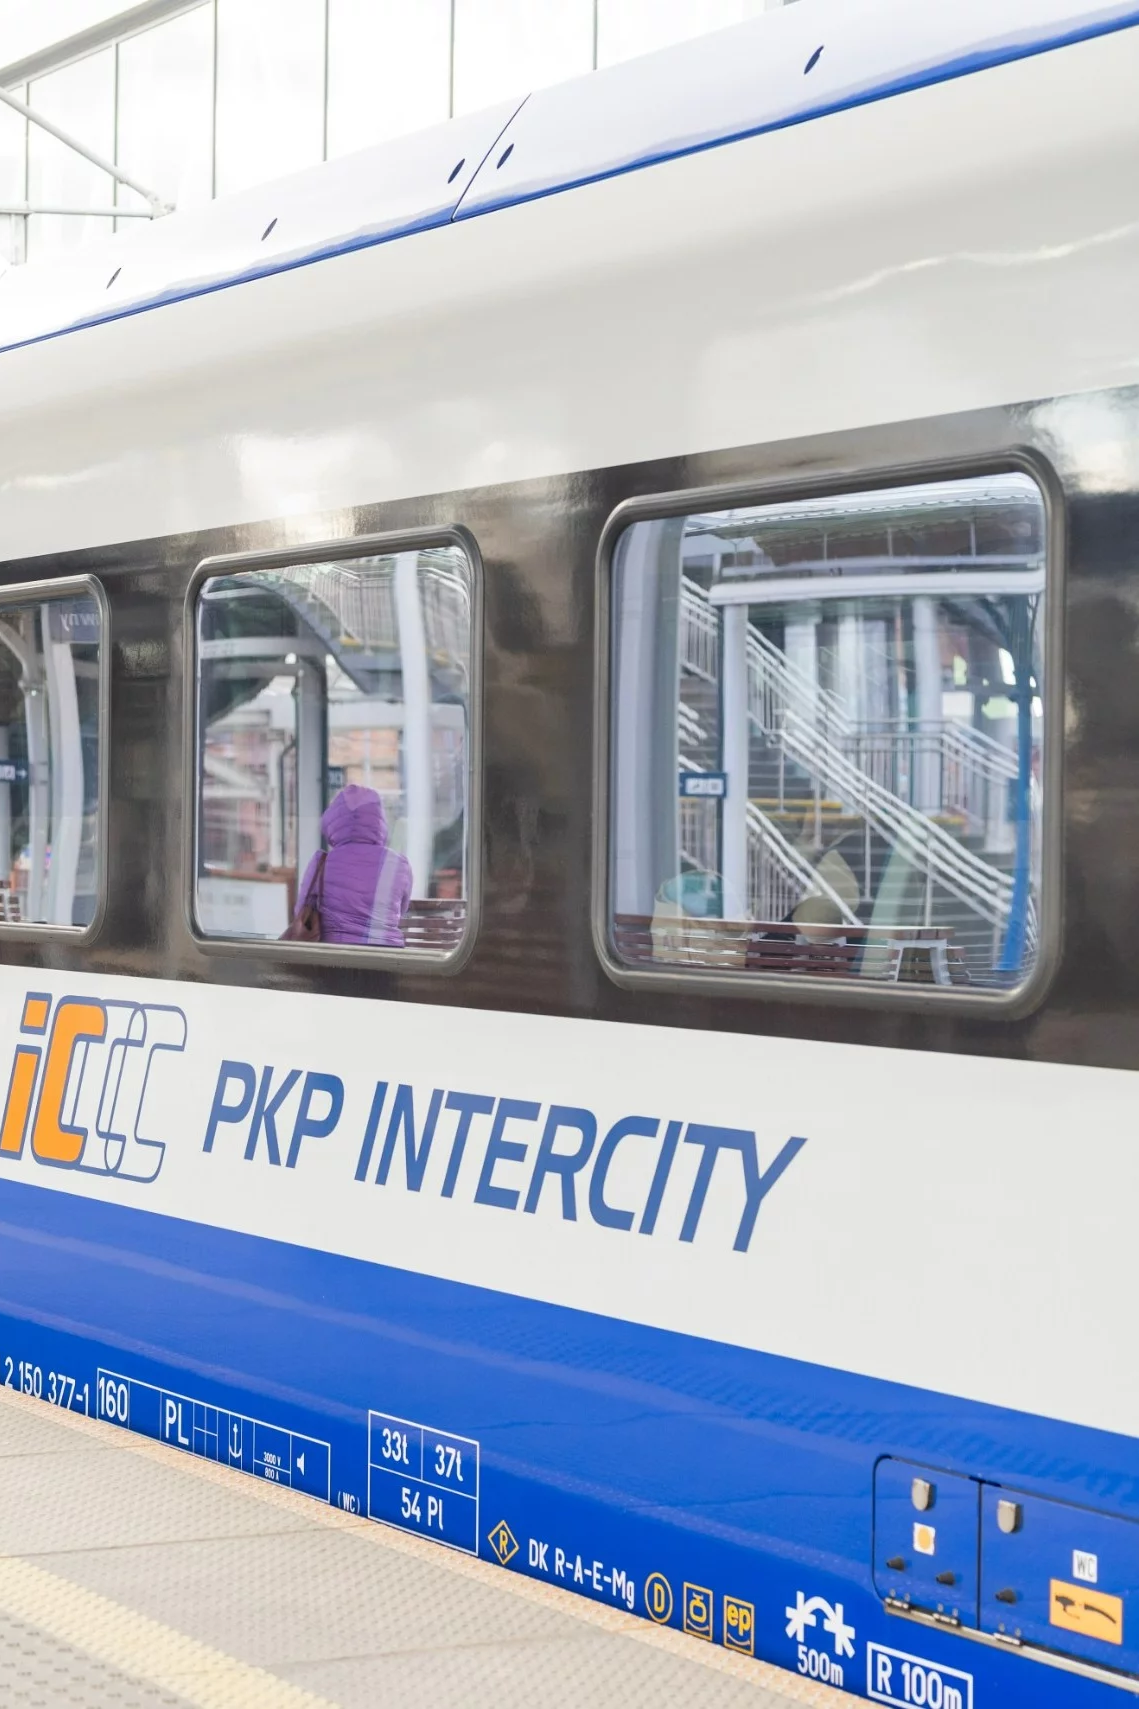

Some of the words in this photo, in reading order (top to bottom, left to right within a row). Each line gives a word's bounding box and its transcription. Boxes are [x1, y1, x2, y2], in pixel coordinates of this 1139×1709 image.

[203, 1059, 344, 1169] PKP
[355, 1081, 807, 1253] INTERCITY
[4, 1356, 14, 1389] 2
[19, 1361, 42, 1399] 150
[48, 1371, 89, 1417] 377-1
[99, 1376, 128, 1422] 160
[165, 1399, 189, 1446] PL
[263, 1451, 277, 1465] 3000
[382, 1428, 409, 1465] 33t
[435, 1444, 463, 1481] 37t
[264, 1467, 275, 1480] 800
[401, 1487, 421, 1523] 54
[499, 1530, 508, 1556] R
[528, 1538, 549, 1572] DK
[555, 1547, 635, 1610] R-A-E-Mg
[1075, 1554, 1095, 1577] WC
[653, 1583, 665, 1613] D
[727, 1604, 751, 1636] ep
[797, 1644, 844, 1688] 500m
[876, 1653, 893, 1695] R
[901, 1661, 963, 1709] 100m
